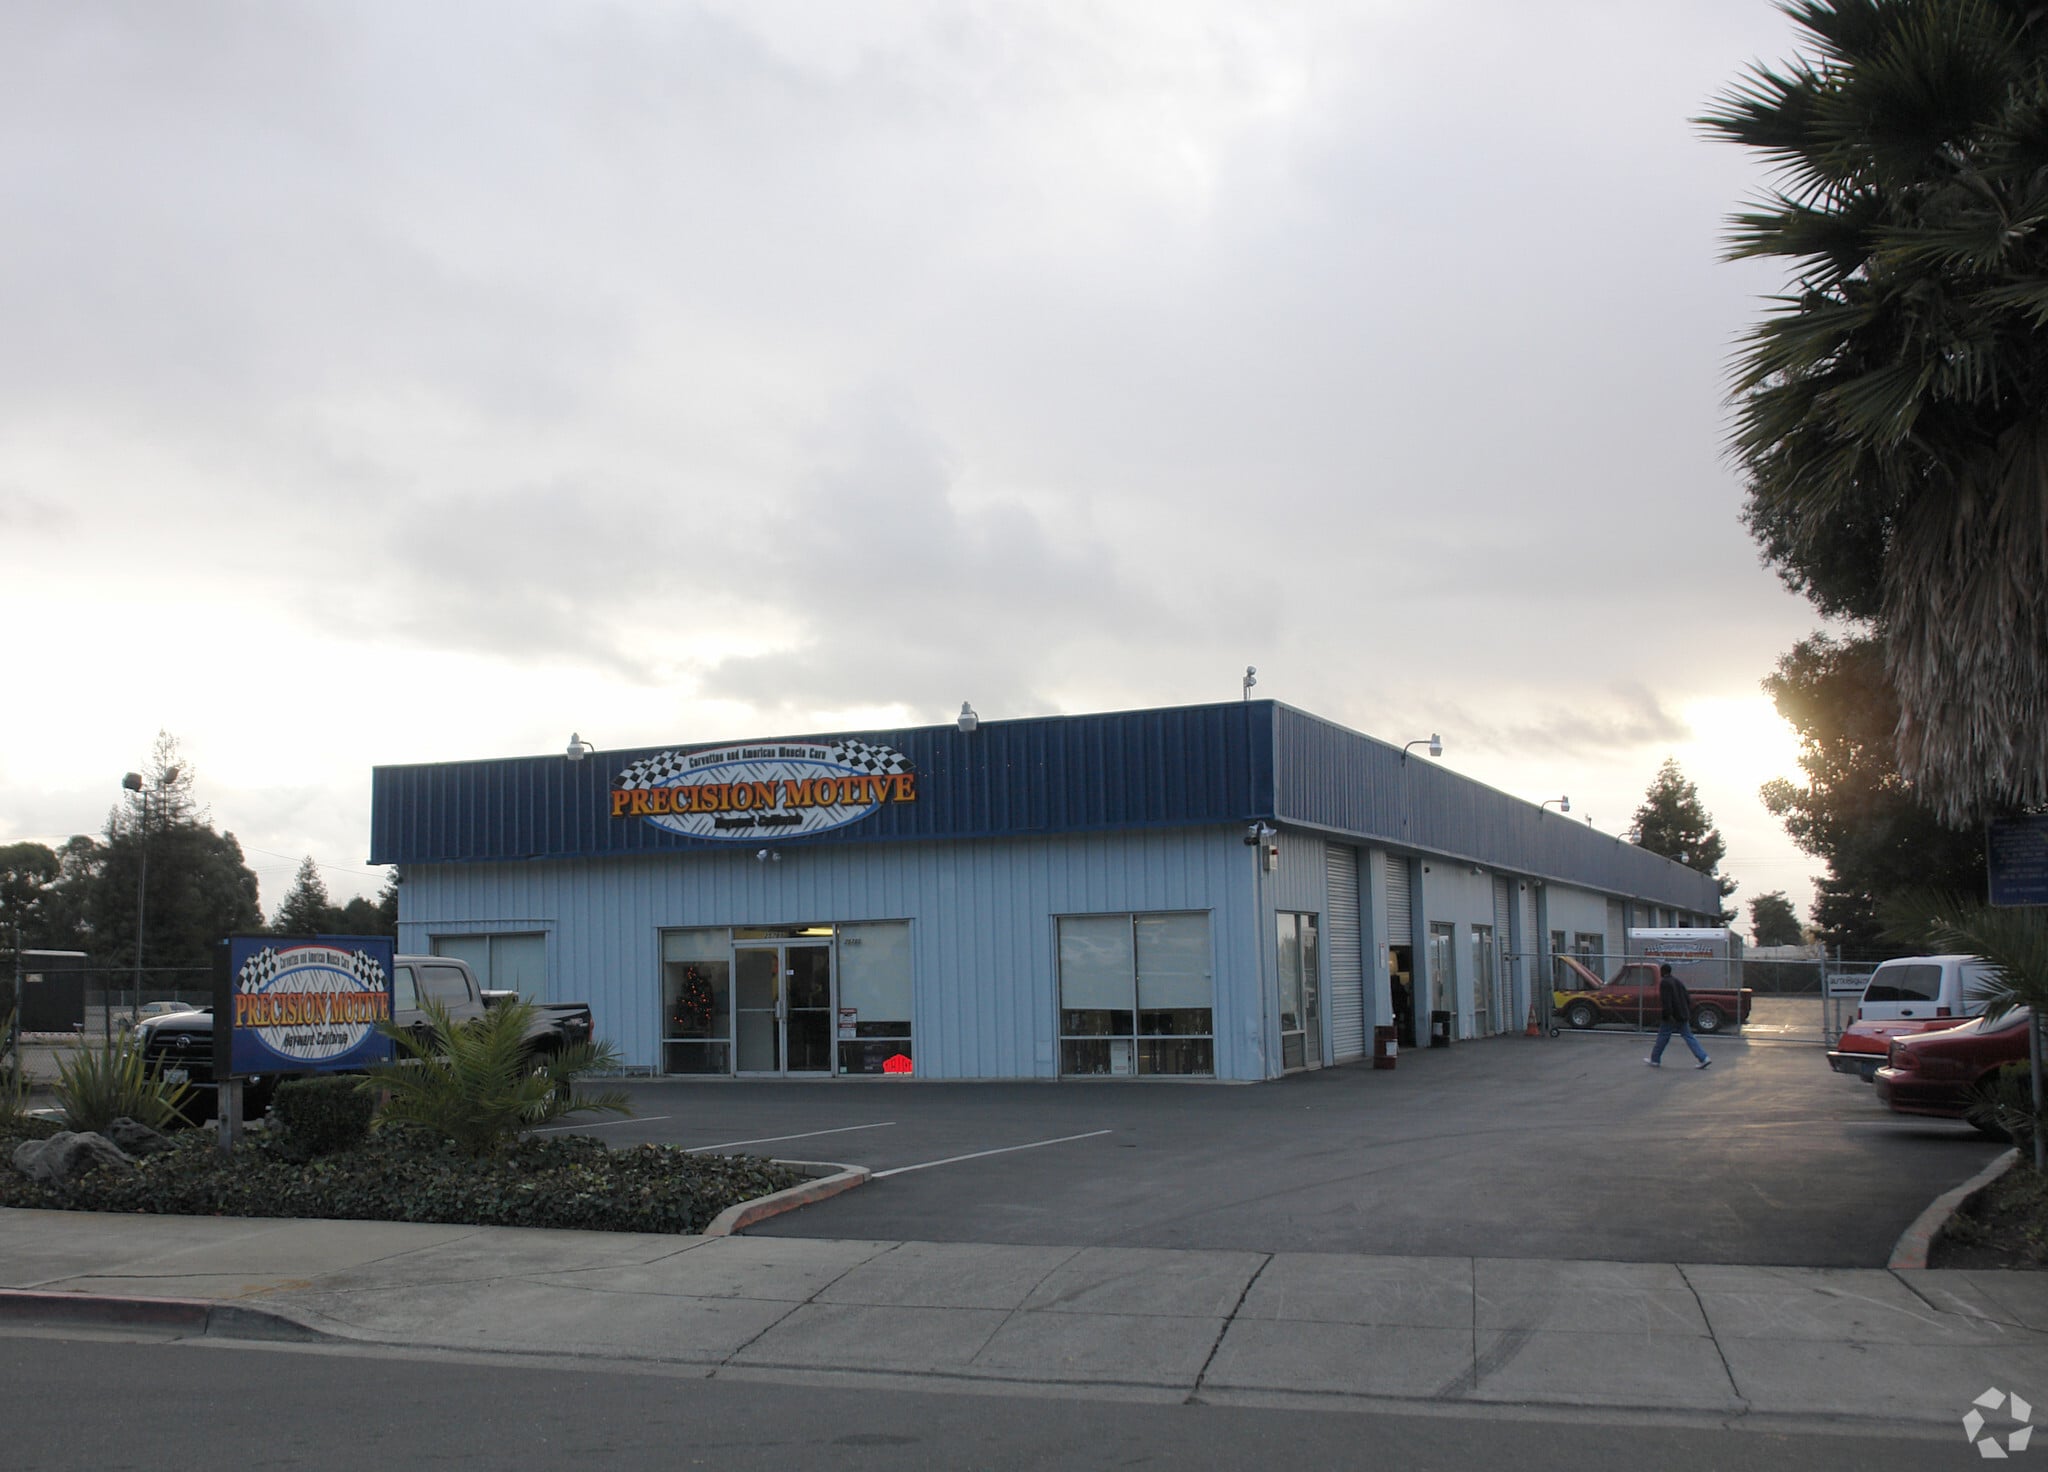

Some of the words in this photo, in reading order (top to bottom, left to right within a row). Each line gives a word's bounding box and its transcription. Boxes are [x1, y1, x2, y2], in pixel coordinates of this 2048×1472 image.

[727, 749, 740, 760] and
[742, 747, 776, 759] American
[809, 748, 827, 760] Cars
[611, 780, 779, 816] PRECISION
[783, 773, 917, 807] MOTIVE
[235, 992, 327, 1028] PRECISION
[329, 991, 390, 1024] MOTIVE
